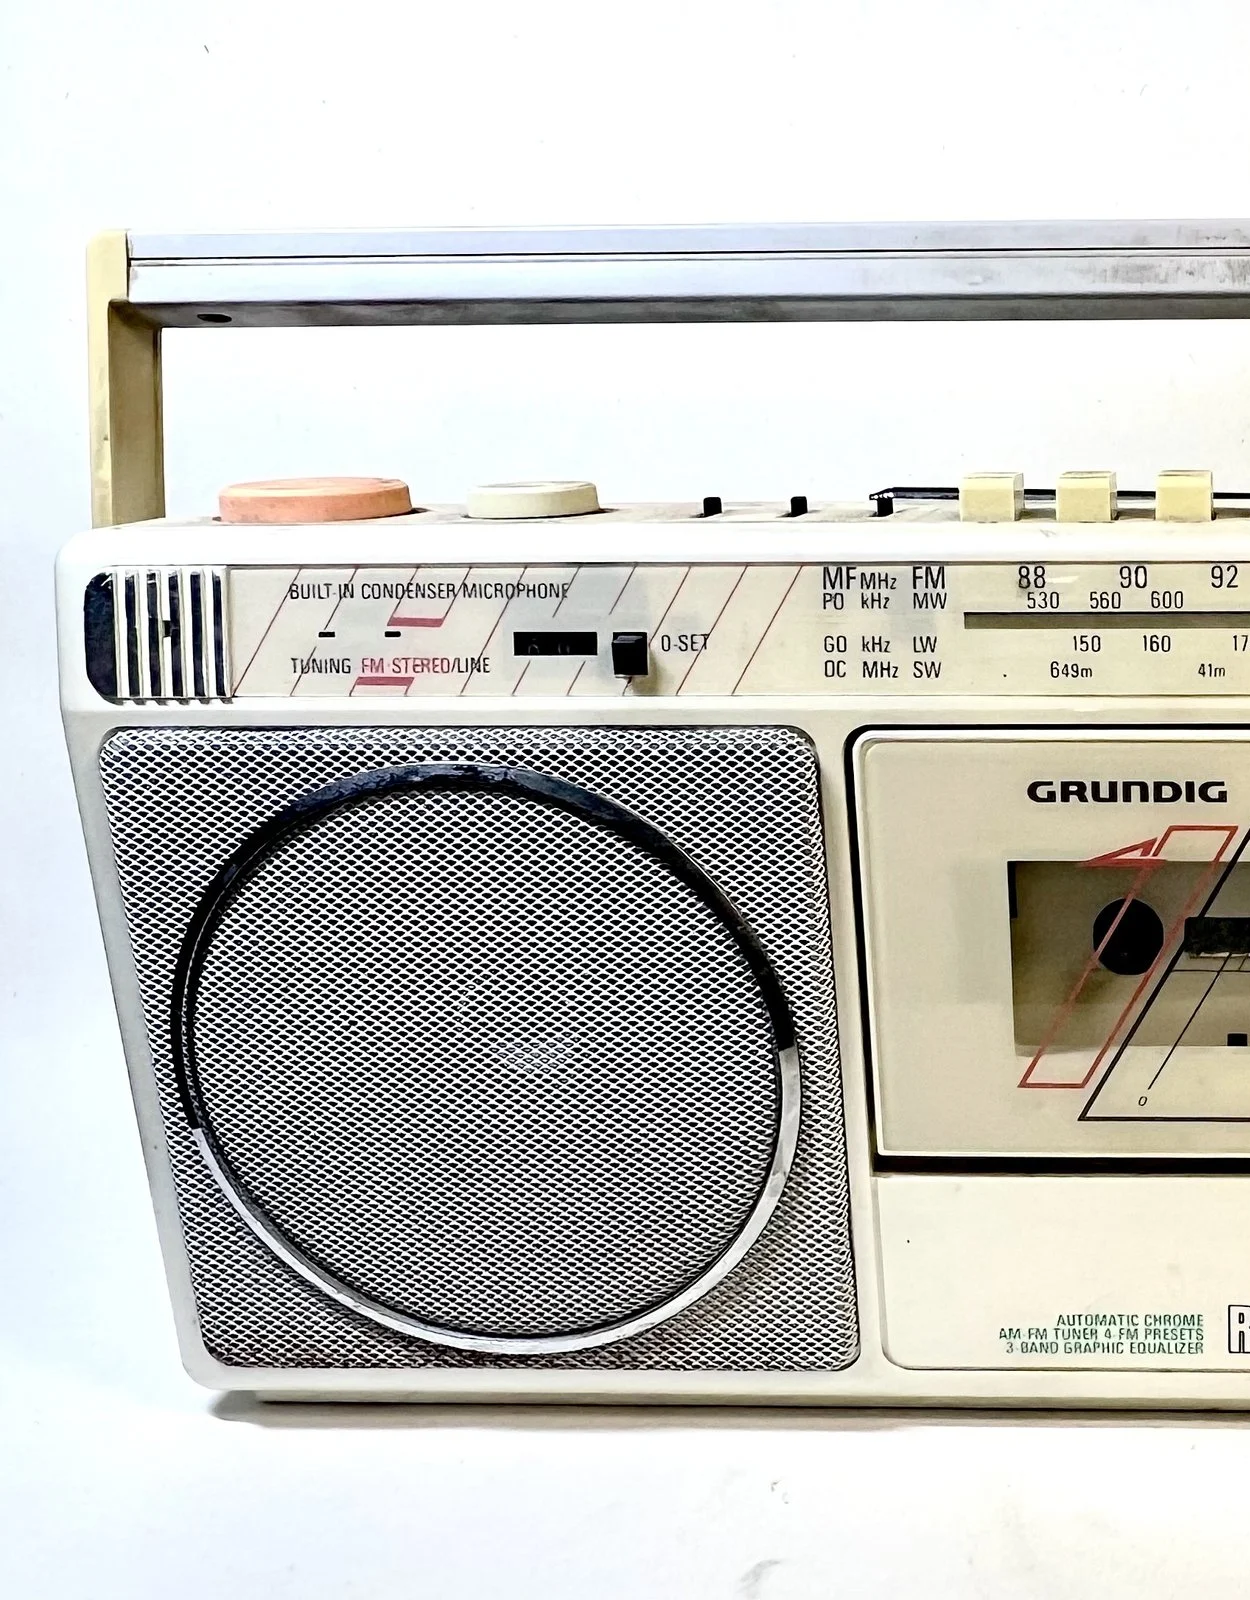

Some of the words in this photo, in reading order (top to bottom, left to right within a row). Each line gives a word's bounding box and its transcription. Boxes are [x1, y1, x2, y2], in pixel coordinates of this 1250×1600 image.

[822, 566, 856, 590] MF
[861, 573, 896, 589] MHz
[913, 566, 945, 589] FM
[1018, 566, 1046, 588] 88
[1119, 566, 1148, 588] 90
[1210, 566, 1239, 588] 92
[361, 583, 456, 600] CONDENSER
[463, 583, 569, 599] MICROPHONE
[823, 593, 844, 610] PO
[861, 593, 890, 610] kHz
[913, 593, 947, 609] MW
[1027, 592, 1060, 609] 530
[1090, 592, 1121, 609] 560
[1151, 592, 1184, 609] 600
[824, 636, 847, 653] GO
[862, 636, 891, 653] kHz
[913, 636, 937, 653] LW
[1073, 635, 1101, 652] 150
[1143, 635, 1171, 652] 160
[291, 658, 351, 675] TUNING
[824, 661, 847, 678] OC
[863, 661, 898, 678] MHz
[913, 661, 942, 678] SW
[1198, 663, 1226, 677] 41m
[1027, 781, 1228, 803] GRUNDIG
[1057, 1314, 1139, 1326] AUTOMATIC
[1145, 1314, 1204, 1327] CHROME
[1054, 1328, 1098, 1340] TUNER
[1145, 1328, 1204, 1340] PRESETS
[1064, 1341, 1124, 1354] GRAPHIC
[1130, 1341, 1204, 1354] EQUALIZER
